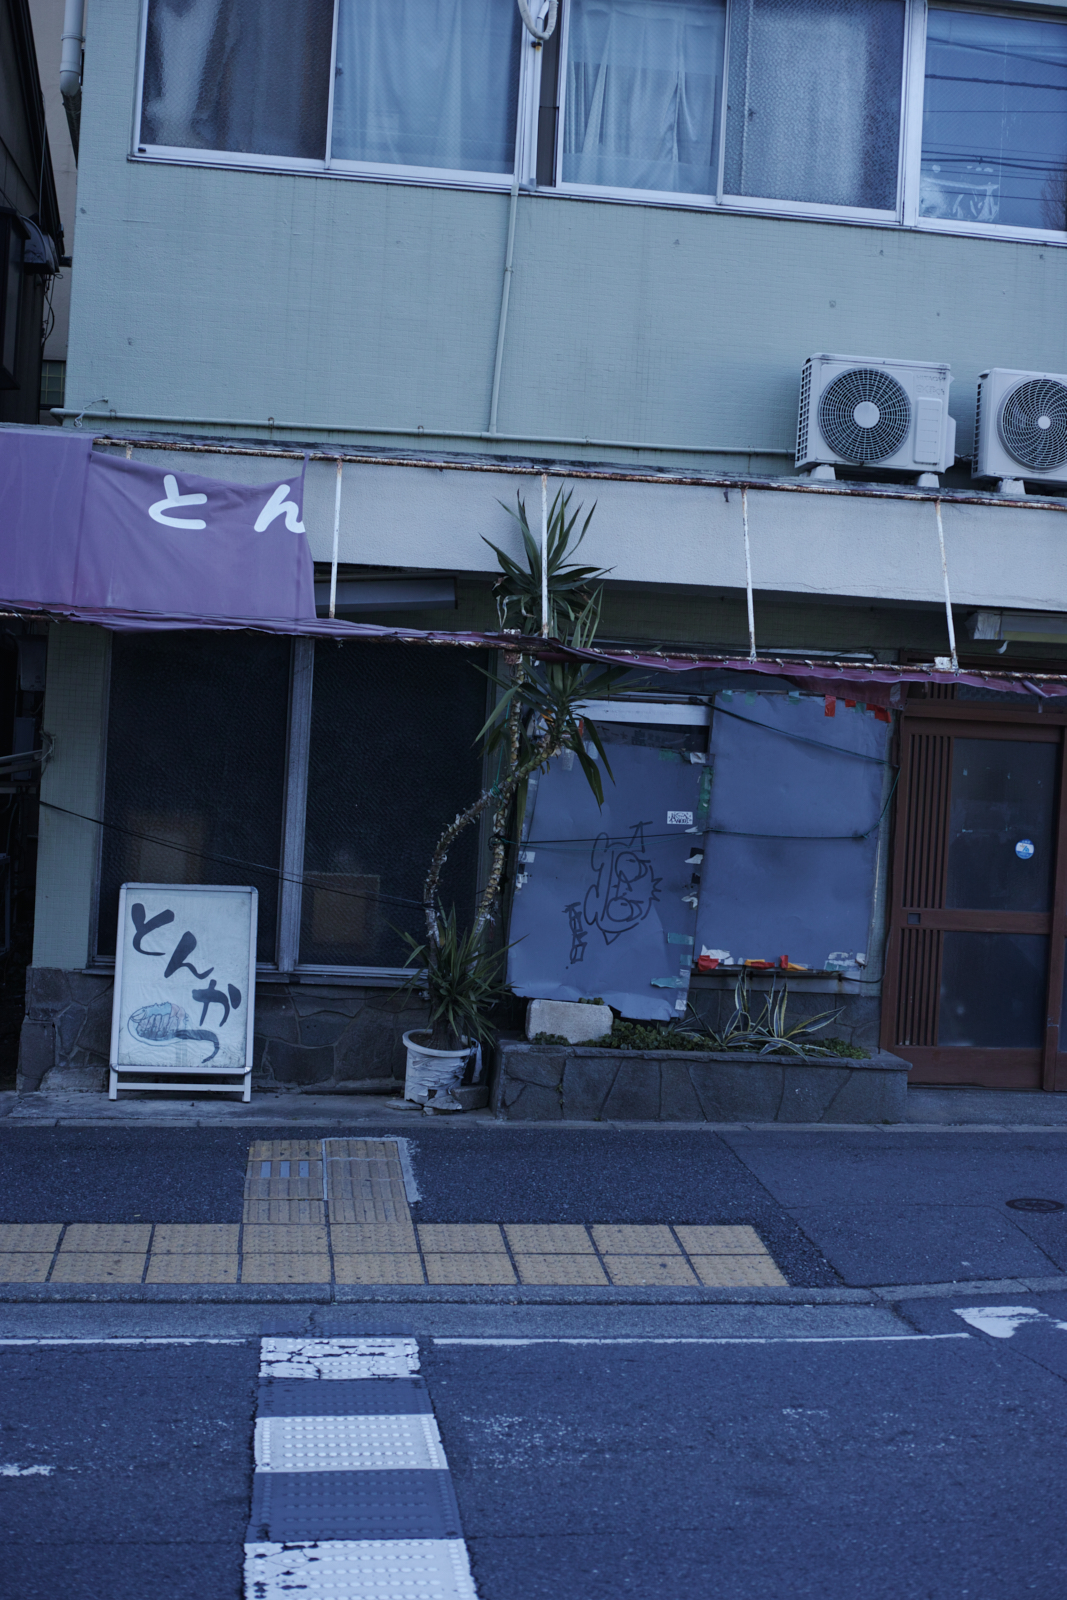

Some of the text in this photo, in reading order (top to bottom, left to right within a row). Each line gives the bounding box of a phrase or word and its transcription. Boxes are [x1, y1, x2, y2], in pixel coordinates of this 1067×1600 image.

[148, 474, 305, 534] とん
[131, 903, 241, 1063] とんかつ
